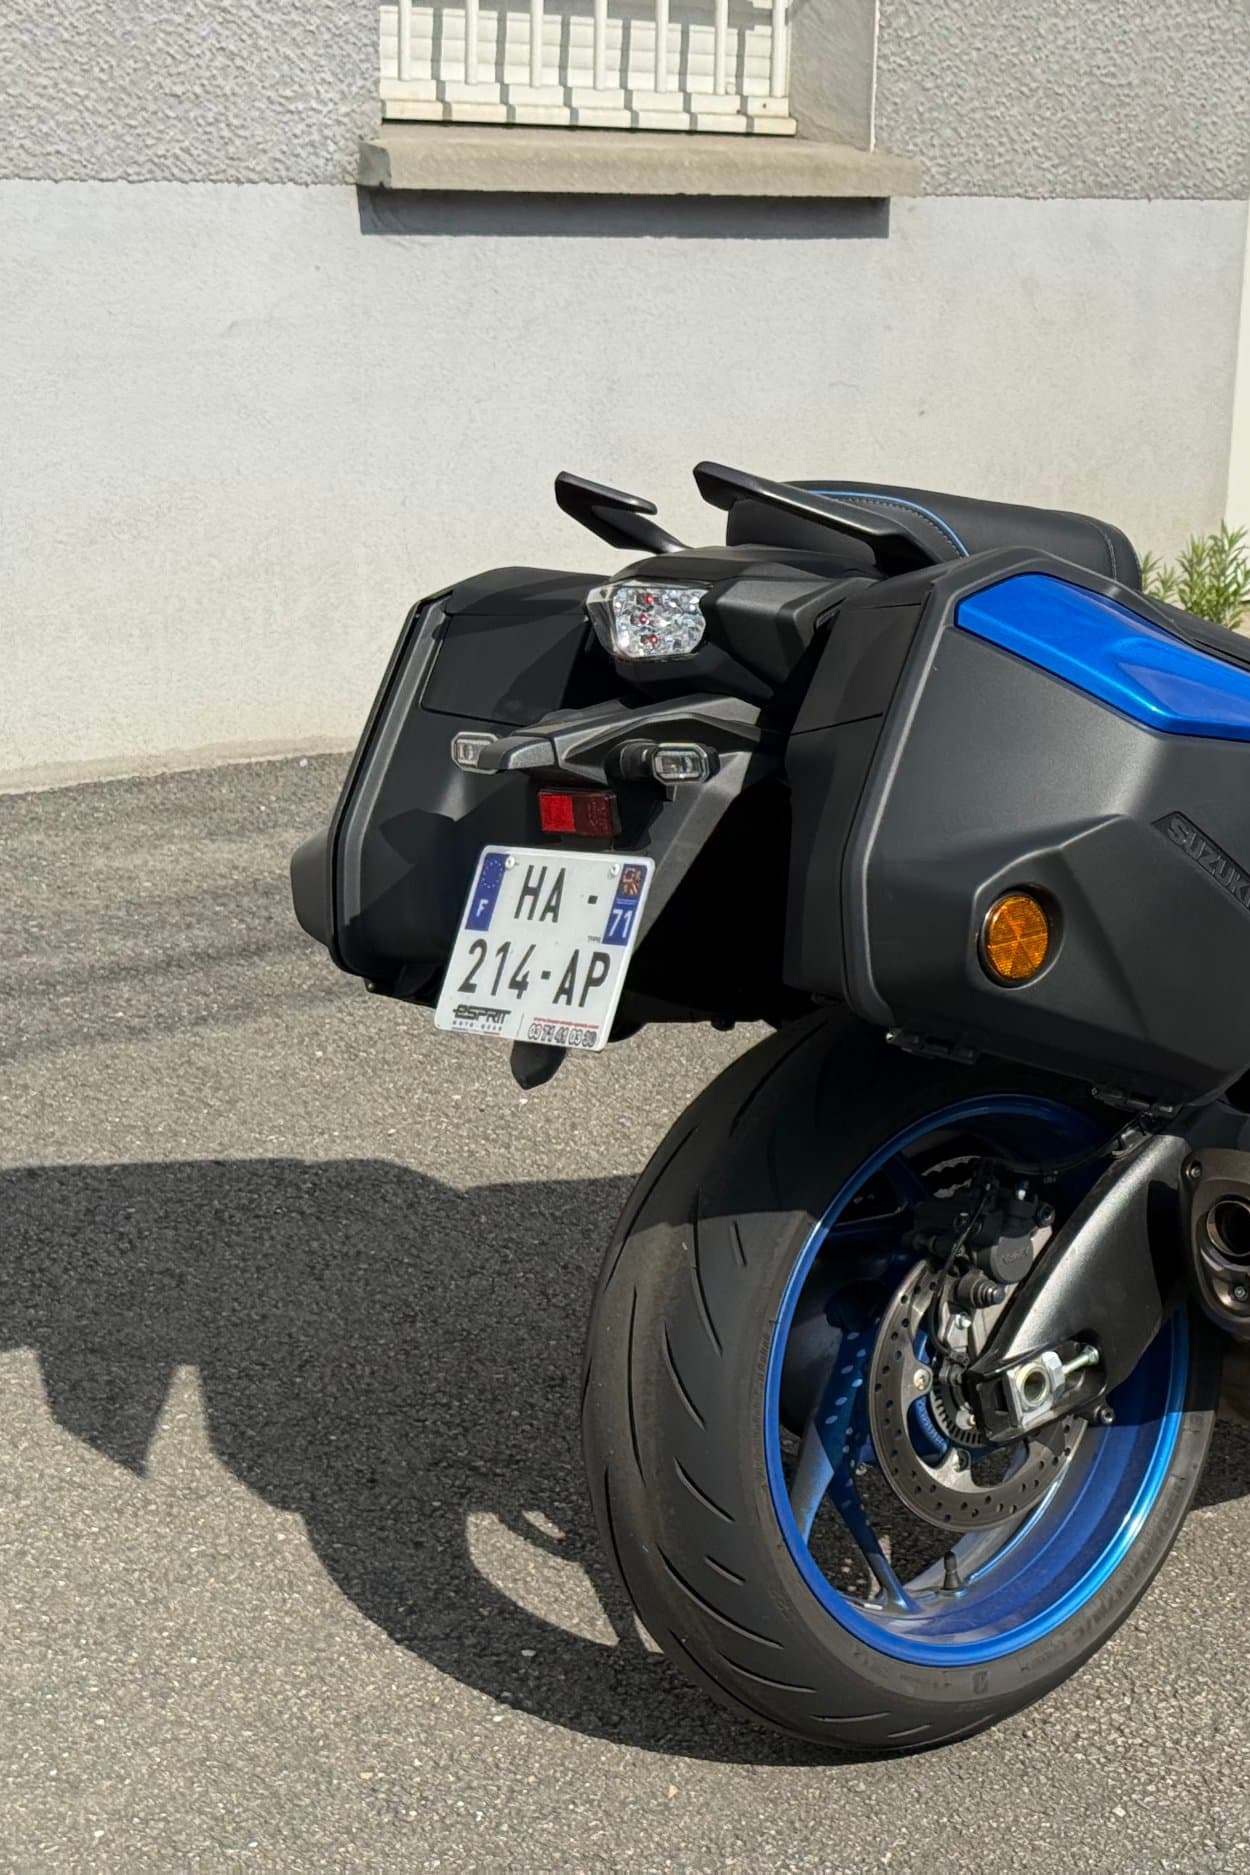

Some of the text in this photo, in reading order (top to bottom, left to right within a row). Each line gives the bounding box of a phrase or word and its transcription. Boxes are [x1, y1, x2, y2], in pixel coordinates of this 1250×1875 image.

[475, 899, 489, 917] F
[514, 864, 566, 923] HA
[608, 908, 633, 938] 71
[457, 938, 611, 1008] 214-AP
